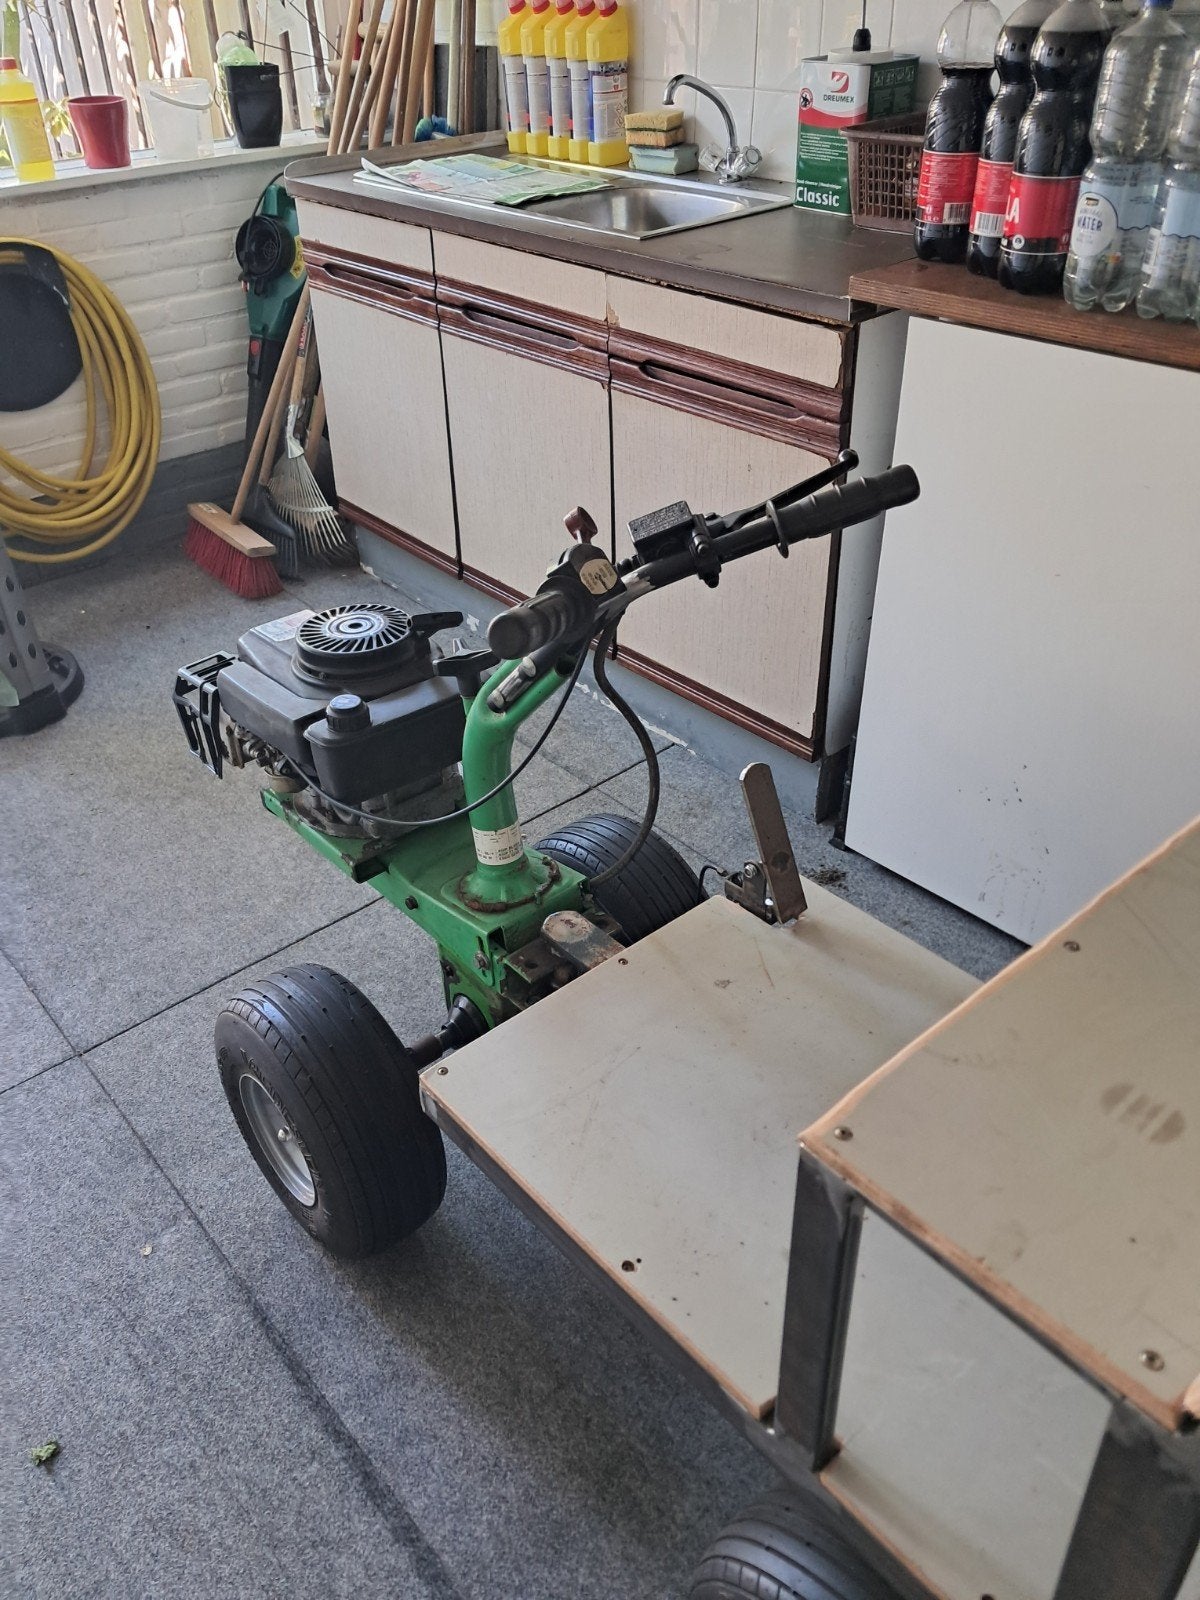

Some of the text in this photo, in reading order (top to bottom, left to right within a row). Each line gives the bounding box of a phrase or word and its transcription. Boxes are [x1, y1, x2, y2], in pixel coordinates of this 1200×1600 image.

[823, 94, 855, 104] DREUMEX
[796, 186, 840, 207] Classic
[1077, 215, 1103, 232] WATER
